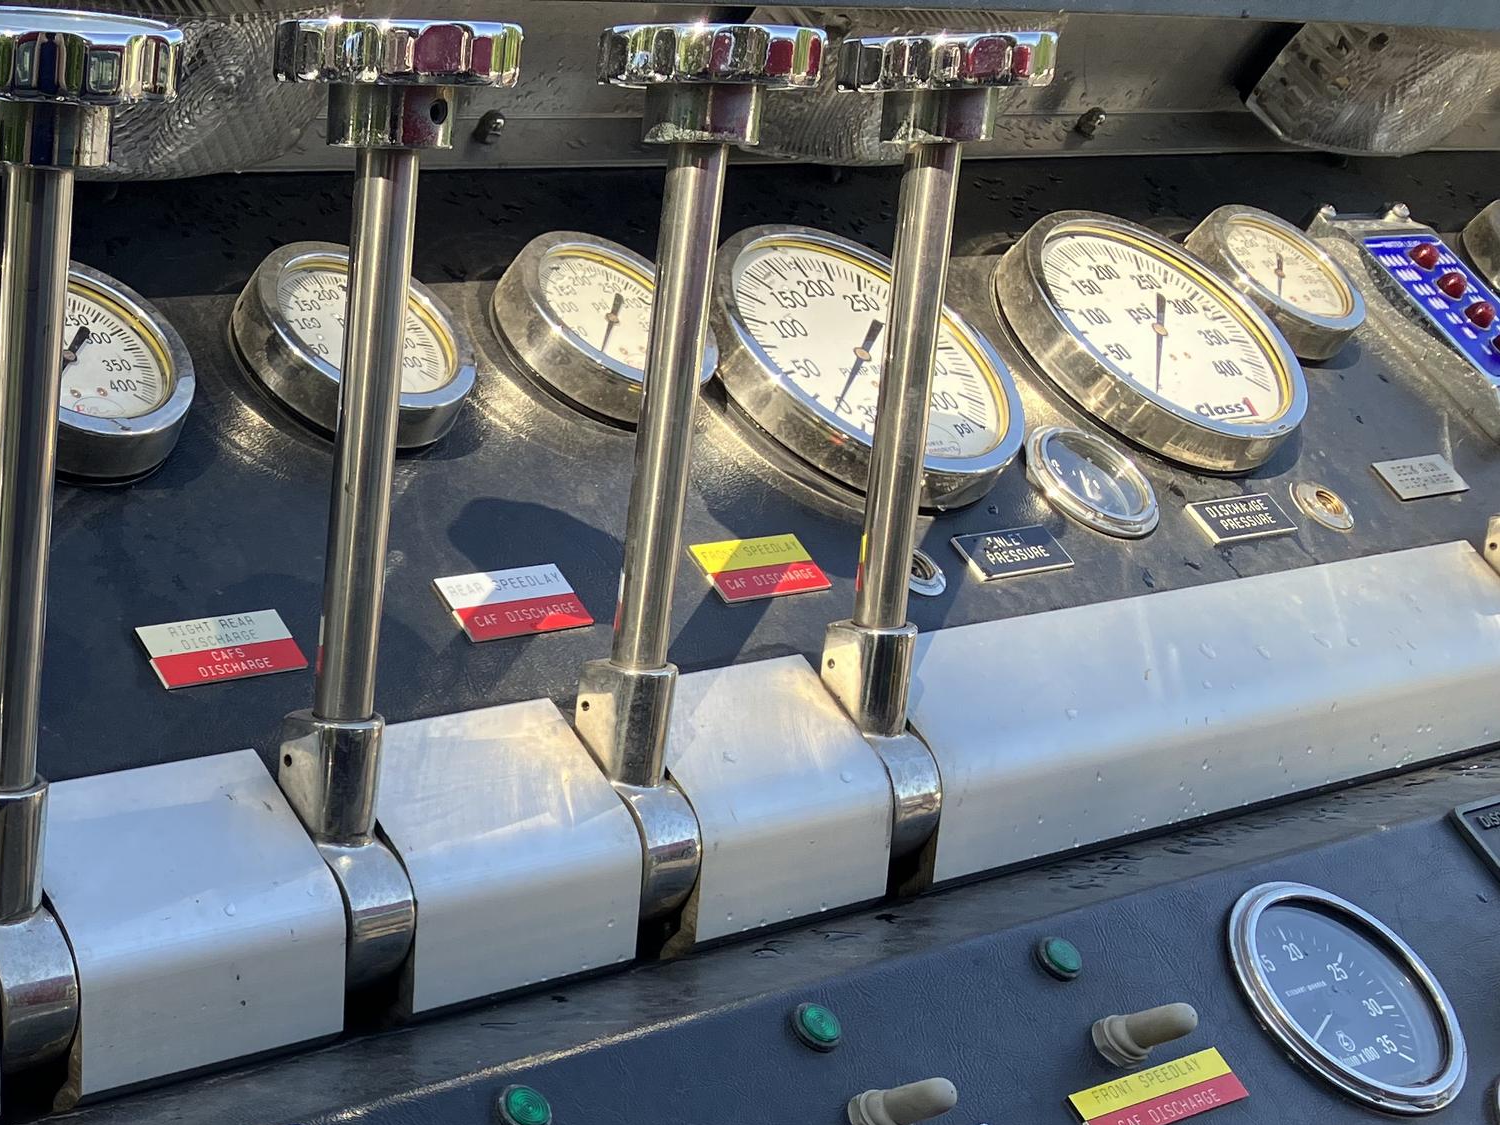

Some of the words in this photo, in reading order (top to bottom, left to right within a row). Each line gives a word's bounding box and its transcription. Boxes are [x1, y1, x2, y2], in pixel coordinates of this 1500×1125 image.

[1088, 265, 1120, 281] 200
[797, 279, 835, 297] 200
[1072, 279, 1103, 296] 150
[1130, 274, 1160, 291] 250
[770, 291, 807, 310] 150
[843, 294, 879, 312] 250
[1168, 299, 1198, 315] 300
[1128, 303, 1155, 325] psi
[770, 319, 808, 338] 100
[1197, 329, 1229, 347] 350
[102, 358, 132, 371] 350
[1214, 359, 1242, 377] 400
[110, 379, 137, 392] 400
[953, 420, 975, 438] psi
[1220, 513, 1277, 530] PRESSURE
[742, 540, 799, 556] SPEEDLAY
[986, 545, 1050, 565] PRESSURE
[492, 572, 560, 591] SPEEDLAY
[725, 578, 748, 590] CAF
[754, 568, 817, 586] DISCHARGE
[473, 613, 498, 627] CAF
[505, 602, 579, 623] DISCHARGE
[167, 621, 212, 638] RIGHT
[218, 615, 255, 629] REAR
[180, 629, 260, 650] DISCHARGE
[211, 647, 246, 662] CAFS
[198, 657, 274, 678] DISCHARGE
[1283, 943, 1303, 961] 20
[1326, 962, 1348, 982] 25
[1362, 998, 1384, 1017] 30
[1376, 1035, 1398, 1055] 35
[1091, 1080, 1134, 1105] FRONT
[1138, 1057, 1201, 1089] SPEEDLAY
[1149, 1088, 1221, 1124] DISCHARGE
